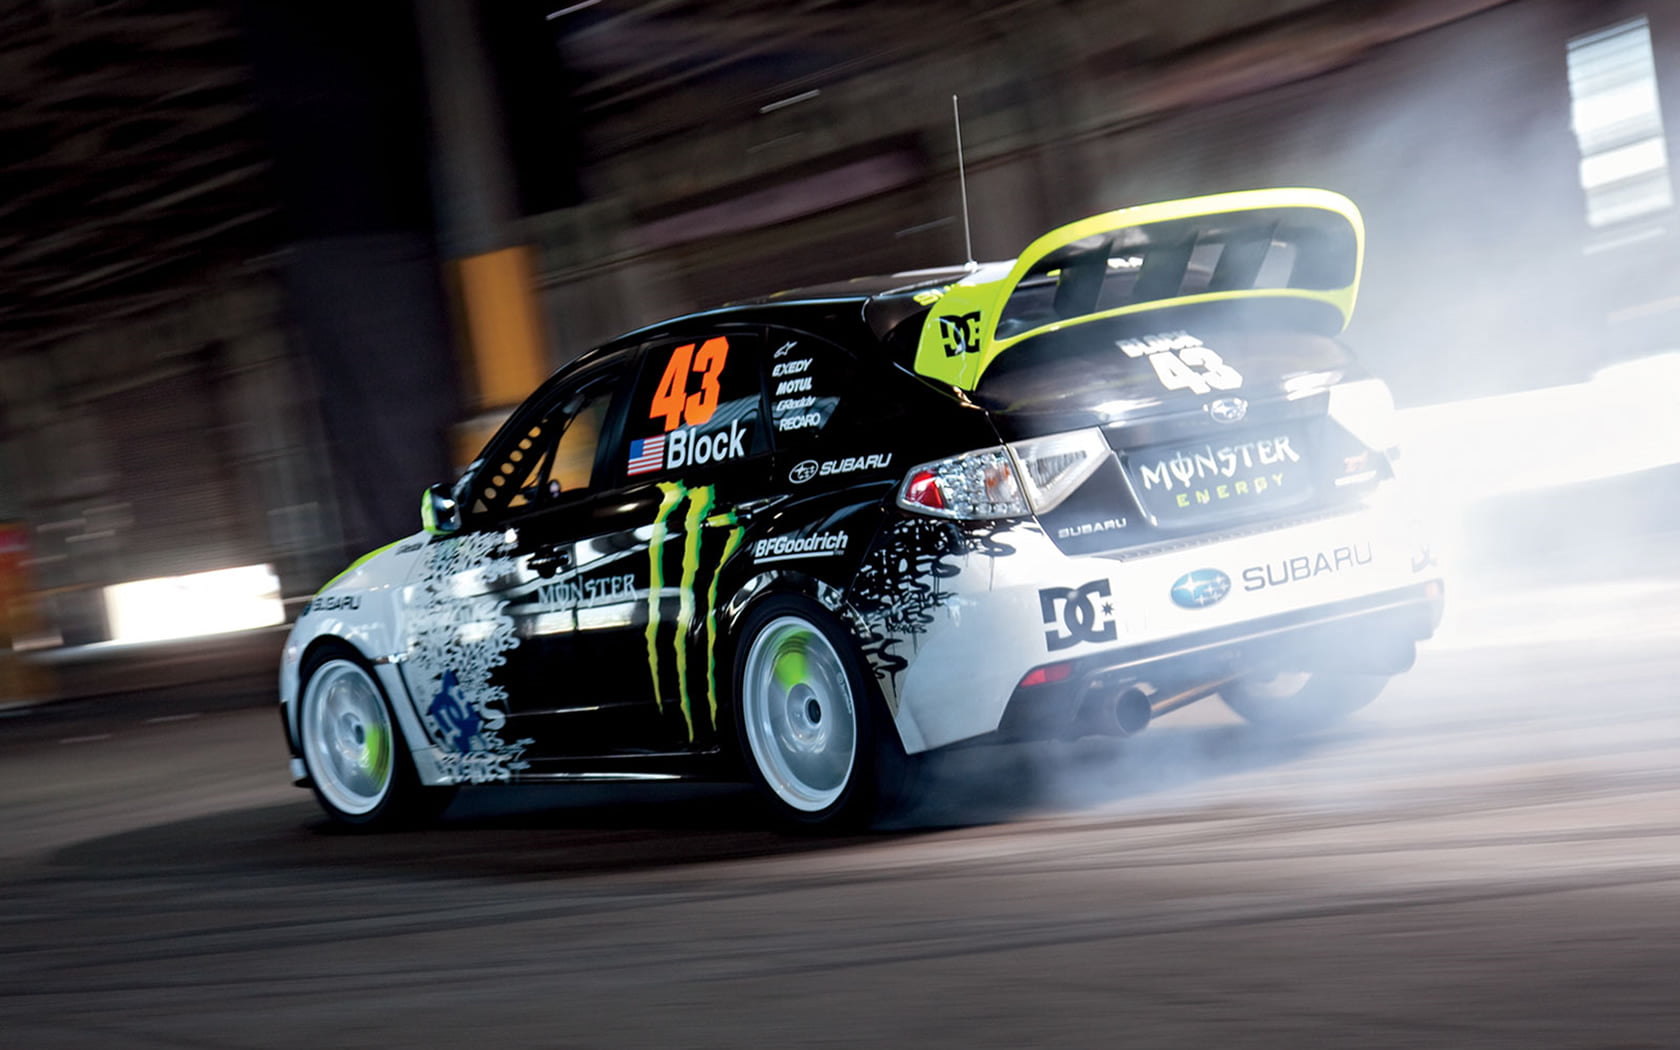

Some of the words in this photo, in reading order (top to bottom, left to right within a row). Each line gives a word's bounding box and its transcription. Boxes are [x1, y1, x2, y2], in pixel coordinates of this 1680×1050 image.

[649, 336, 729, 432] 43
[772, 358, 813, 377] EXEDY
[1148, 346, 1243, 395] 43
[776, 376, 813, 396] MOTUL
[779, 412, 821, 432] RECARO
[666, 419, 746, 470] Block
[819, 453, 893, 476] SUBARU
[1140, 435, 1300, 491] MONSTER
[1176, 473, 1284, 507] ENERGY
[754, 530, 849, 558] BFGoodrich
[1058, 518, 1127, 539] SUBARU
[1241, 542, 1374, 592] SUBARU
[538, 574, 638, 612] MONSTER
[1038, 578, 1118, 652] DC
